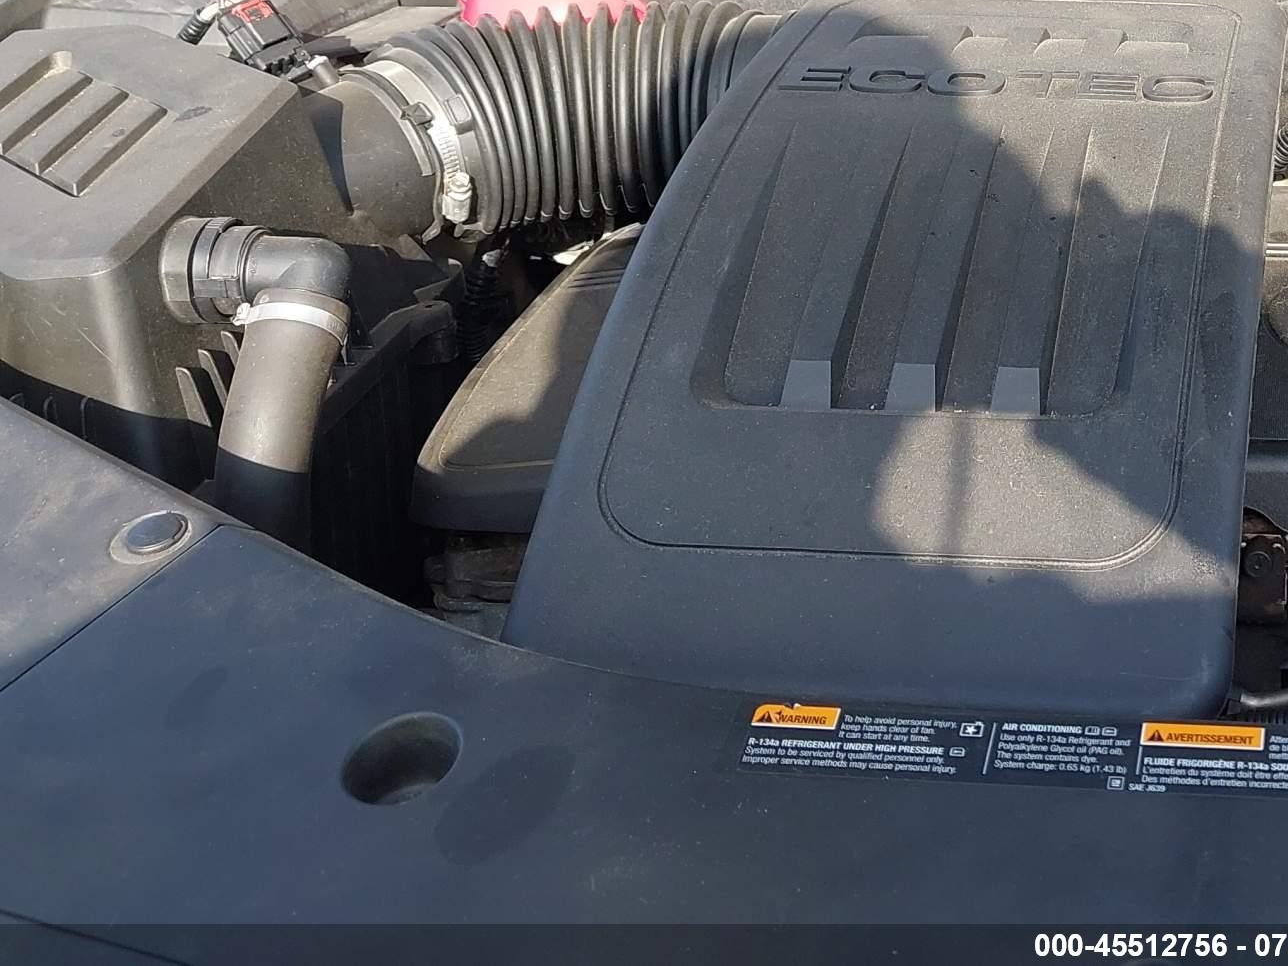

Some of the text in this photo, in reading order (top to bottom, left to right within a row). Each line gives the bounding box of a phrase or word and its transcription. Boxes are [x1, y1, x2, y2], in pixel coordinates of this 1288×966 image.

[777, 65, 1215, 103] ECOTEC
[778, 714, 827, 725] WARNING
[845, 714, 853, 722] To
[855, 716, 872, 724] help
[934, 720, 957, 729] injury.
[841, 723, 860, 731] keep
[863, 724, 887, 732] hands
[1002, 723, 1082, 734] AIR CONDITIONING
[1000, 733, 1016, 741] Use
[1017, 734, 1035, 742] only
[1036, 735, 1067, 744] R-134a
[1068, 736, 1114, 746] Refrigerant
[1166, 733, 1253, 744] AVERTISSEMENT
[748, 737, 944, 755] R-134a REFRIGERANT UNDER HIGH PRESSURE
[998, 742, 1048, 752] Polyalkylene
[1050, 744, 1075, 753] Glycol
[1088, 746, 1108, 754] (PAG
[744, 746, 775, 754] System
[787, 748, 798, 756] be
[799, 750, 834, 758] serviced
[836, 750, 846, 760] by
[847, 752, 882, 761] qualified
[884, 754, 924, 762] personnel
[926, 756, 944, 764] only.
[1013, 752, 1043, 760] system
[1044, 754, 1079, 762] contains
[1081, 755, 1098, 764] dye.
[742, 754, 779, 764] Improper
[812, 758, 848, 767] methods
[894, 764, 930, 772] personal
[932, 765, 956, 774] injury.
[994, 760, 1024, 768] System
[1026, 761, 1057, 771] charge:
[1080, 765, 1091, 773] kg
[1092, 765, 1114, 774] (1.43
[1116, 766, 1127, 774] lb)
[1144, 757, 1175, 766] FLUIDE
[1177, 758, 1236, 769] FRIGORIGÈNE
[1237, 761, 1269, 770] R-134a
[1142, 766, 1186, 775] L'entretien
[1200, 769, 1235, 778] système
[1237, 770, 1252, 778] doit
[1142, 775, 1158, 783] Des
[1160, 776, 1200, 785] méthodes
[1202, 778, 1247, 787] d'entretien
[1128, 783, 1166, 792] SAE J639
